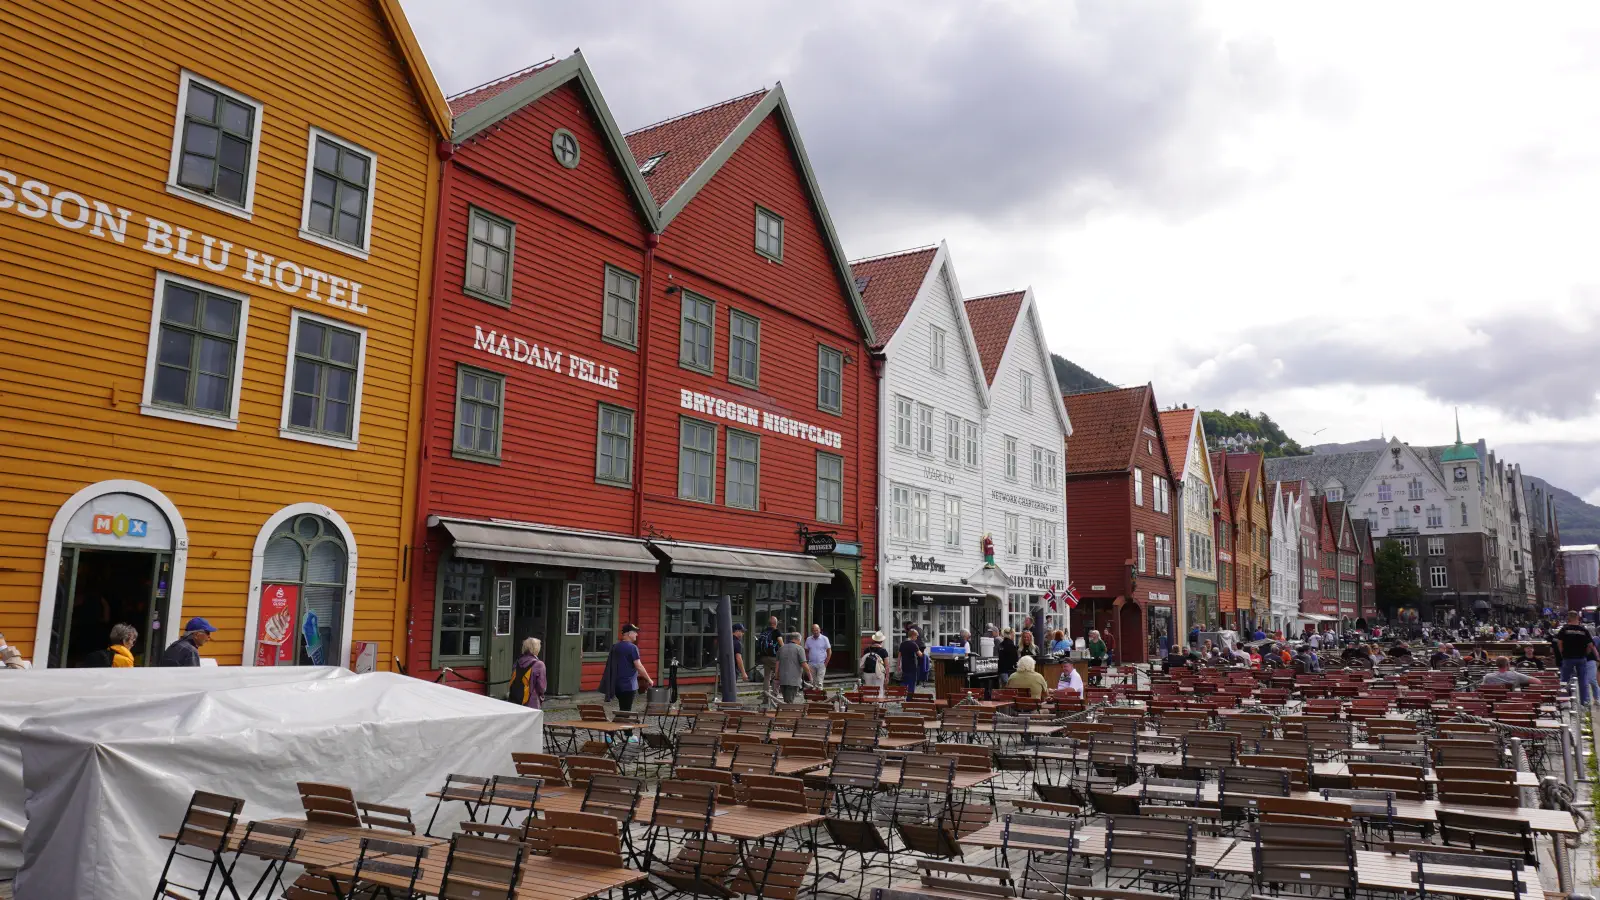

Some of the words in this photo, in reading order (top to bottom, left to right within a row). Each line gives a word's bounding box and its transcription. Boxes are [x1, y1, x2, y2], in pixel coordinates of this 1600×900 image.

[142, 216, 233, 271] BLU
[242, 248, 368, 314] HOTEL
[473, 325, 562, 373] MADAM
[568, 354, 620, 390] FELLE
[680, 388, 759, 427] BRYGGEN
[762, 412, 842, 449] NIGHTCLUB
[991, 490, 1018, 504] NETWORK
[95, 516, 145, 535] MIX
[1024, 564, 1050, 577] JUHLS'
